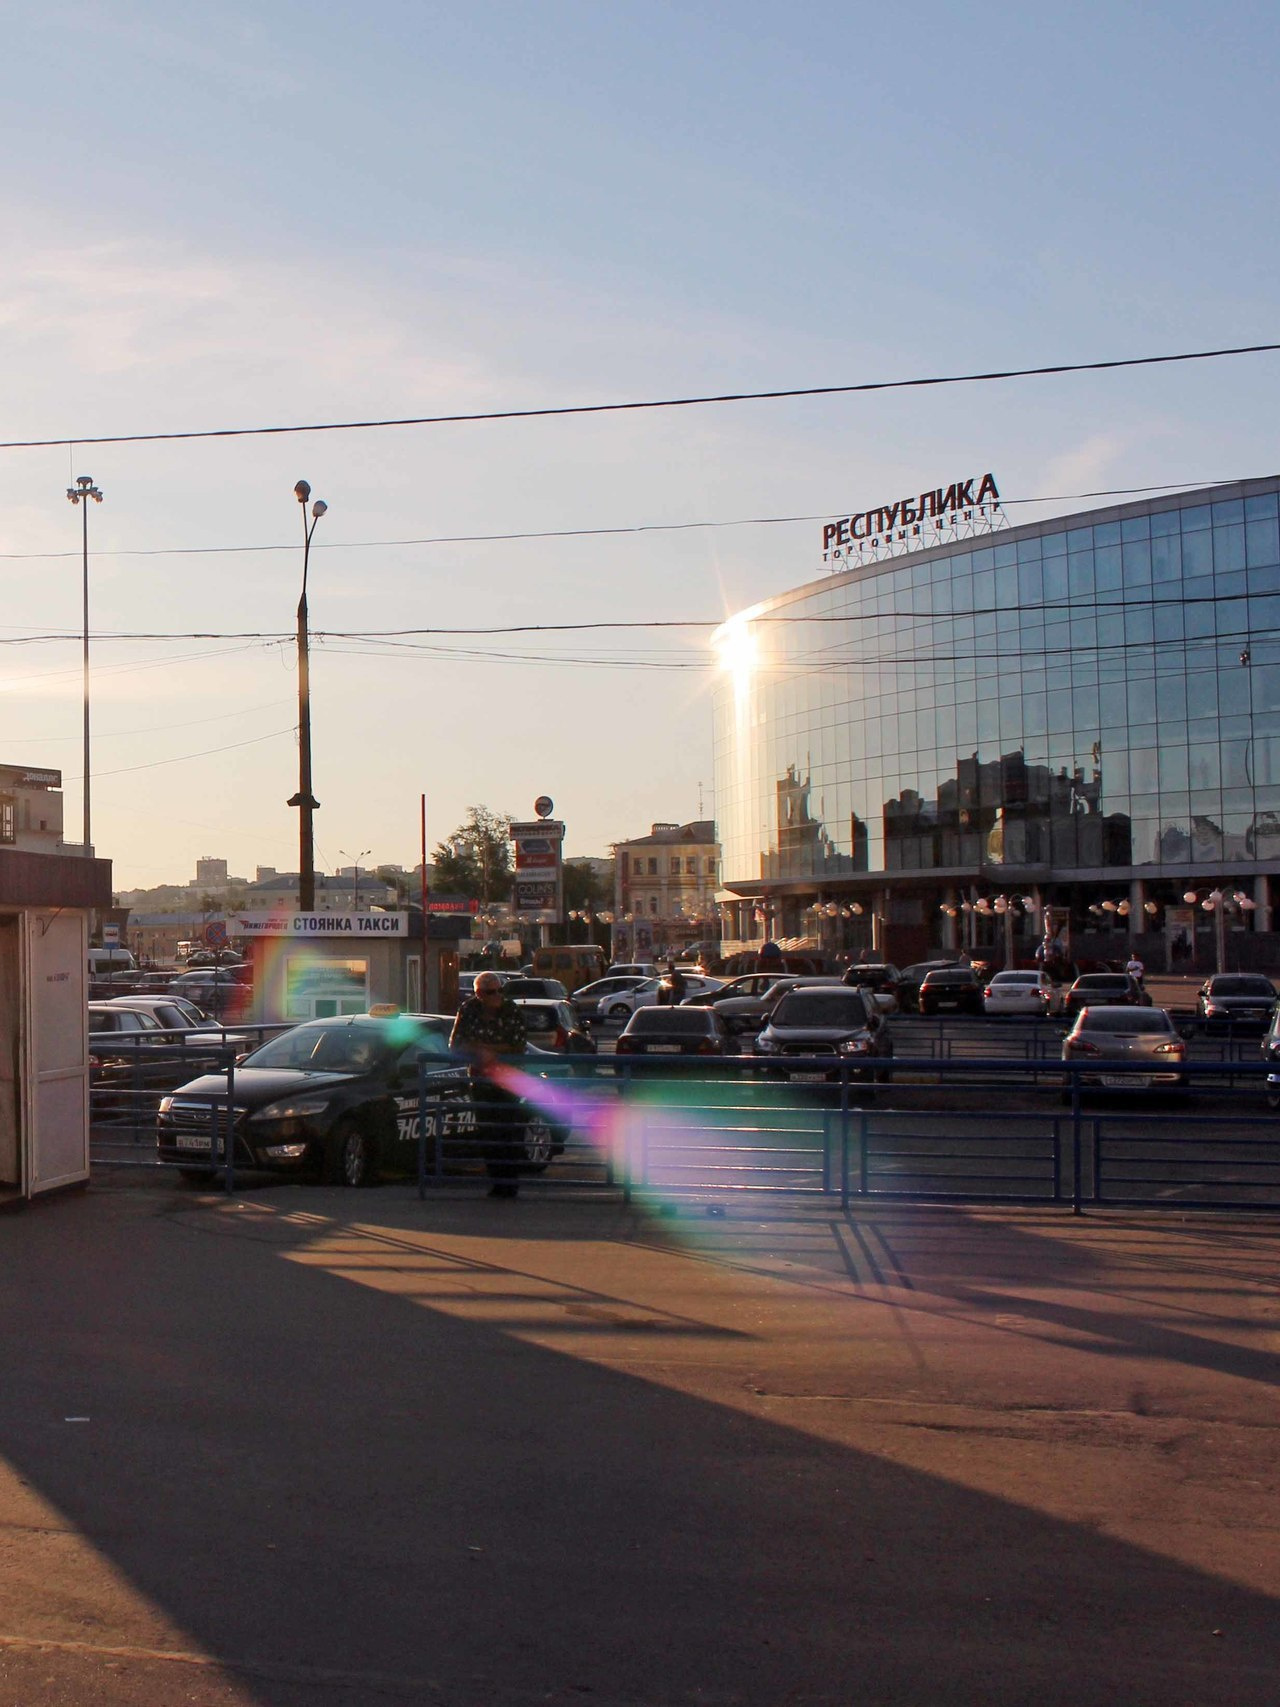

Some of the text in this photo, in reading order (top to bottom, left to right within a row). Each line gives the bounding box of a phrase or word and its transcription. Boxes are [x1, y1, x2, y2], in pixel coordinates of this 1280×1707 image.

[822, 501, 1000, 562] ТОРГОВЫЙ ЦЕНТР
[823, 473, 999, 549] РЕСПУБЛИКА
[293, 917, 352, 931] СТОЯНКА
[357, 917, 399, 931] ТАКСИ
